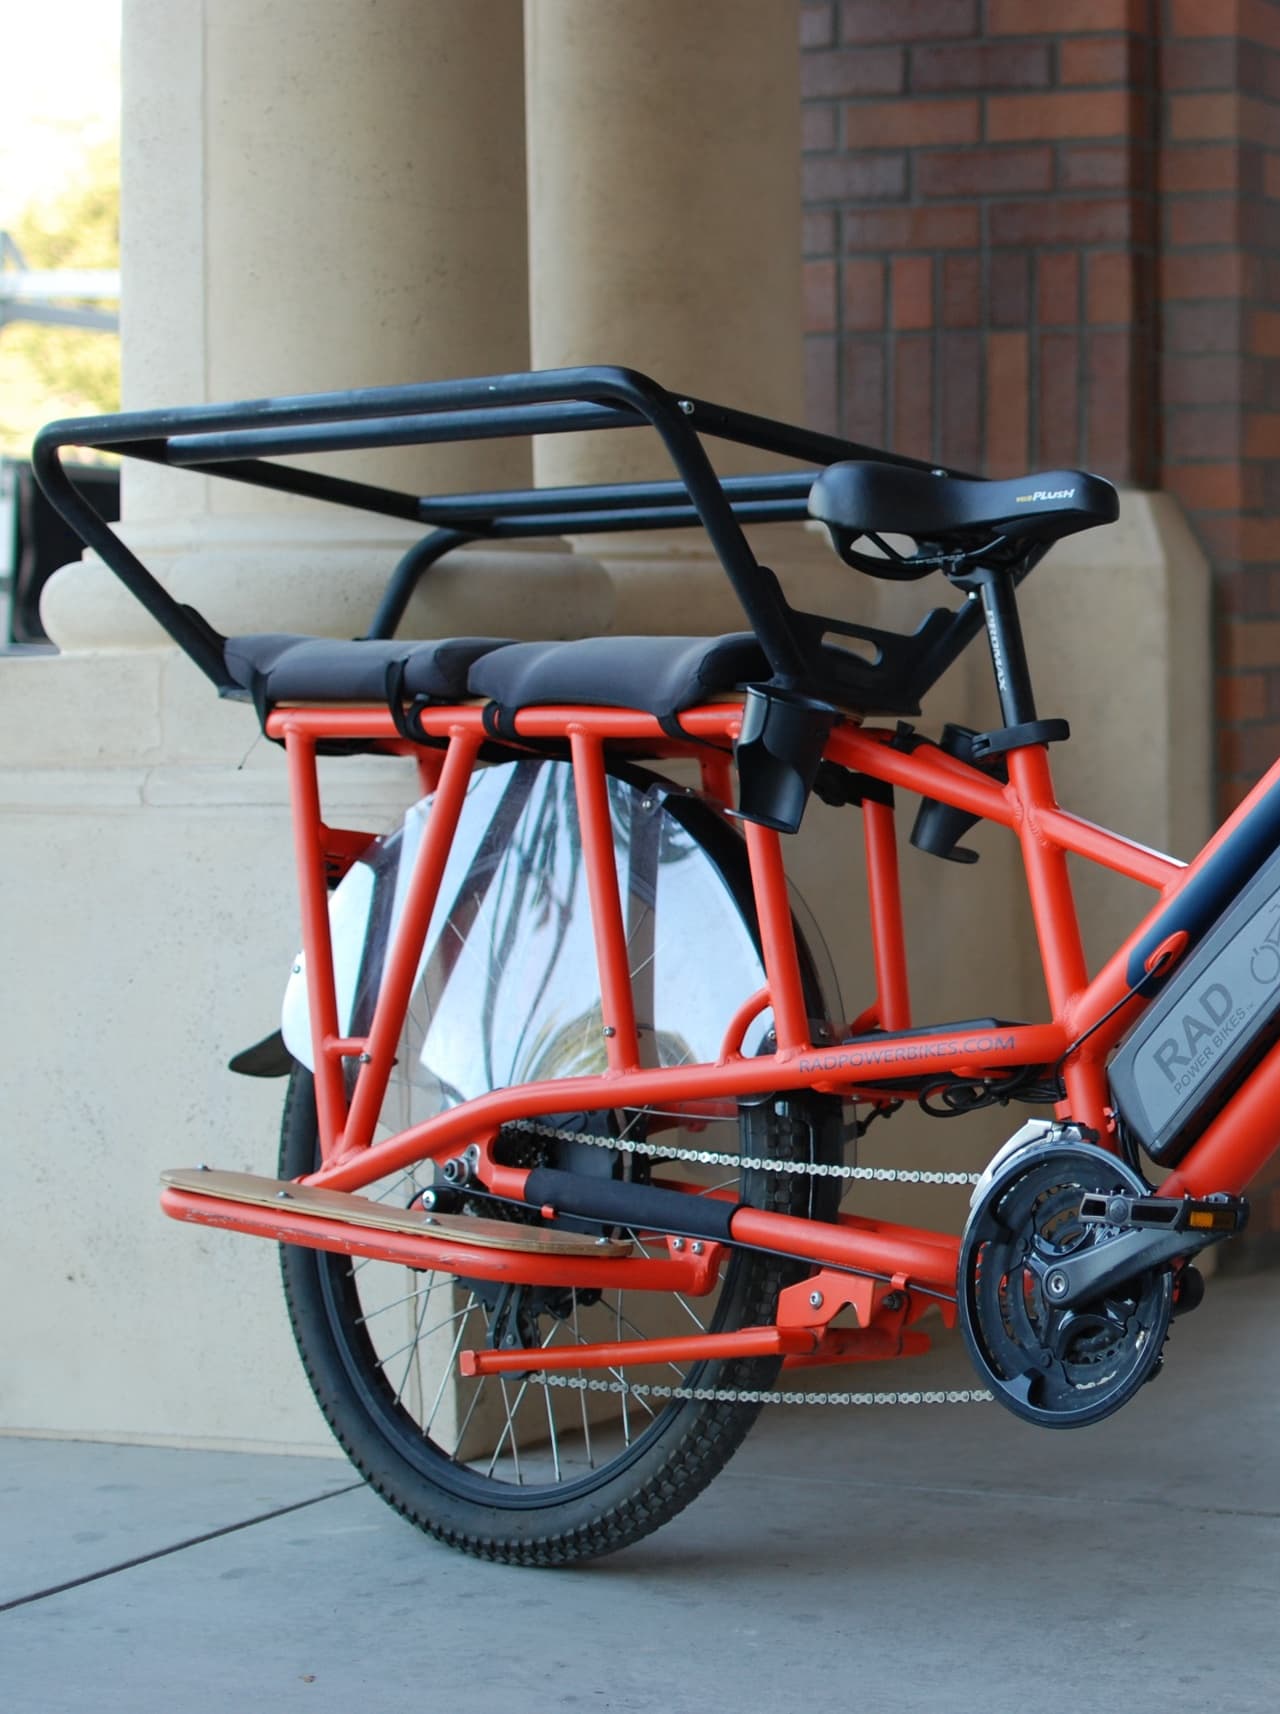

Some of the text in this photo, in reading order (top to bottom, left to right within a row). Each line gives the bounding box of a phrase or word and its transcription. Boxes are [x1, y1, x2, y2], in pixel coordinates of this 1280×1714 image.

[1032, 488, 1076, 501] PLUSH
[986, 609, 1007, 691] PROMAX
[799, 1036, 1016, 1073] RADPOWERBIKES.COM
[1152, 983, 1234, 1084] RAD
[1173, 1007, 1247, 1095] POWER BIKES
